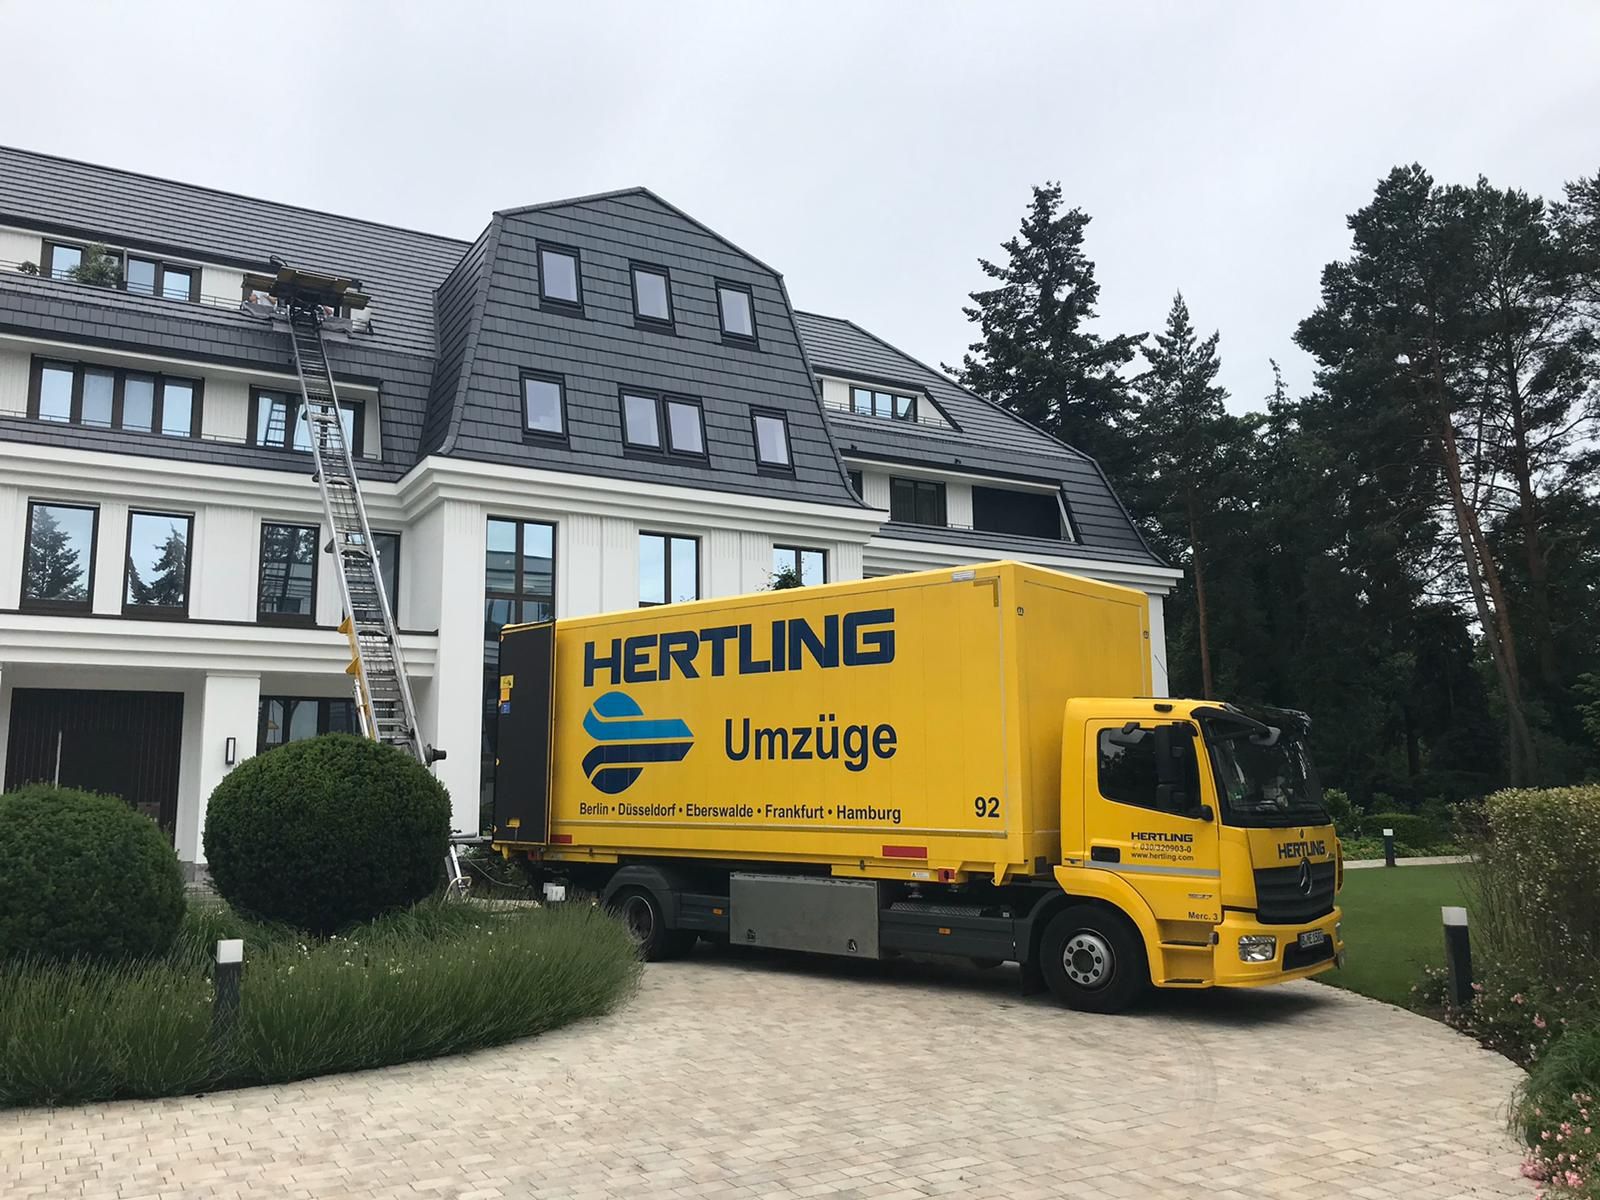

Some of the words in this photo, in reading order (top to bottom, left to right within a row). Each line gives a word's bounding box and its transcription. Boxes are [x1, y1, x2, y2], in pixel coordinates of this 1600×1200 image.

[584, 608, 895, 687] HERTLING
[725, 714, 897, 771] Umzüge
[580, 802, 609, 816] Berlin
[618, 803, 676, 817] Düsseldorf
[686, 804, 754, 818] Eberswalde
[765, 805, 824, 819] Frankfurt
[836, 806, 902, 824] Hamburg
[975, 797, 1000, 817] 92
[1131, 832, 1193, 842] HERTLING
[1131, 852, 1194, 862] www.hertling.com
[1277, 840, 1326, 859] HERTLING
[1188, 911, 1211, 920] Merc.
[1212, 912, 1218, 920] 3
